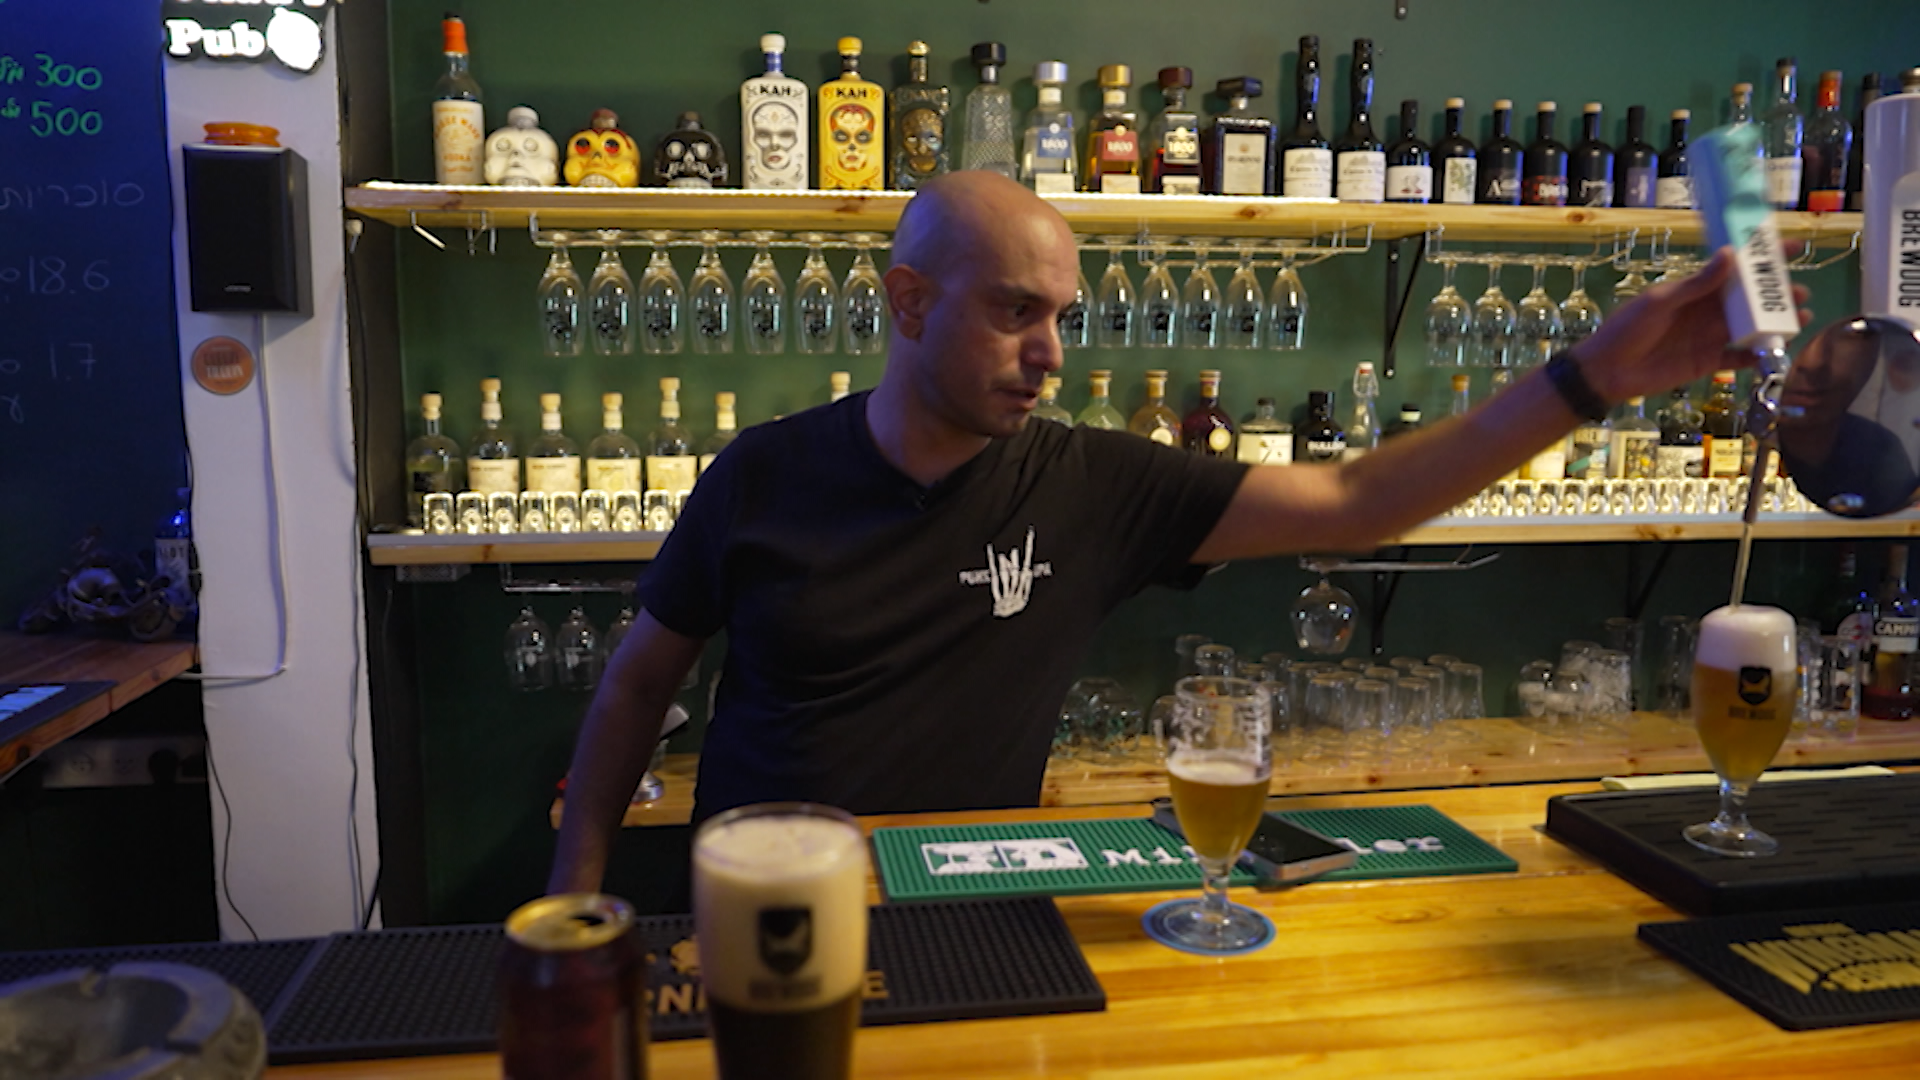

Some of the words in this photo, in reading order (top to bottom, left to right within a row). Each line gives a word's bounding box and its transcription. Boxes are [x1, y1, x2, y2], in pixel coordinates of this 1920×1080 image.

[165, 18, 266, 57] Pub
[34, 53, 103, 90] 300
[759, 85, 791, 96] KAH
[835, 87, 867, 98] KAH
[29, 100, 103, 137] 500
[28, 255, 110, 294] 18.6
